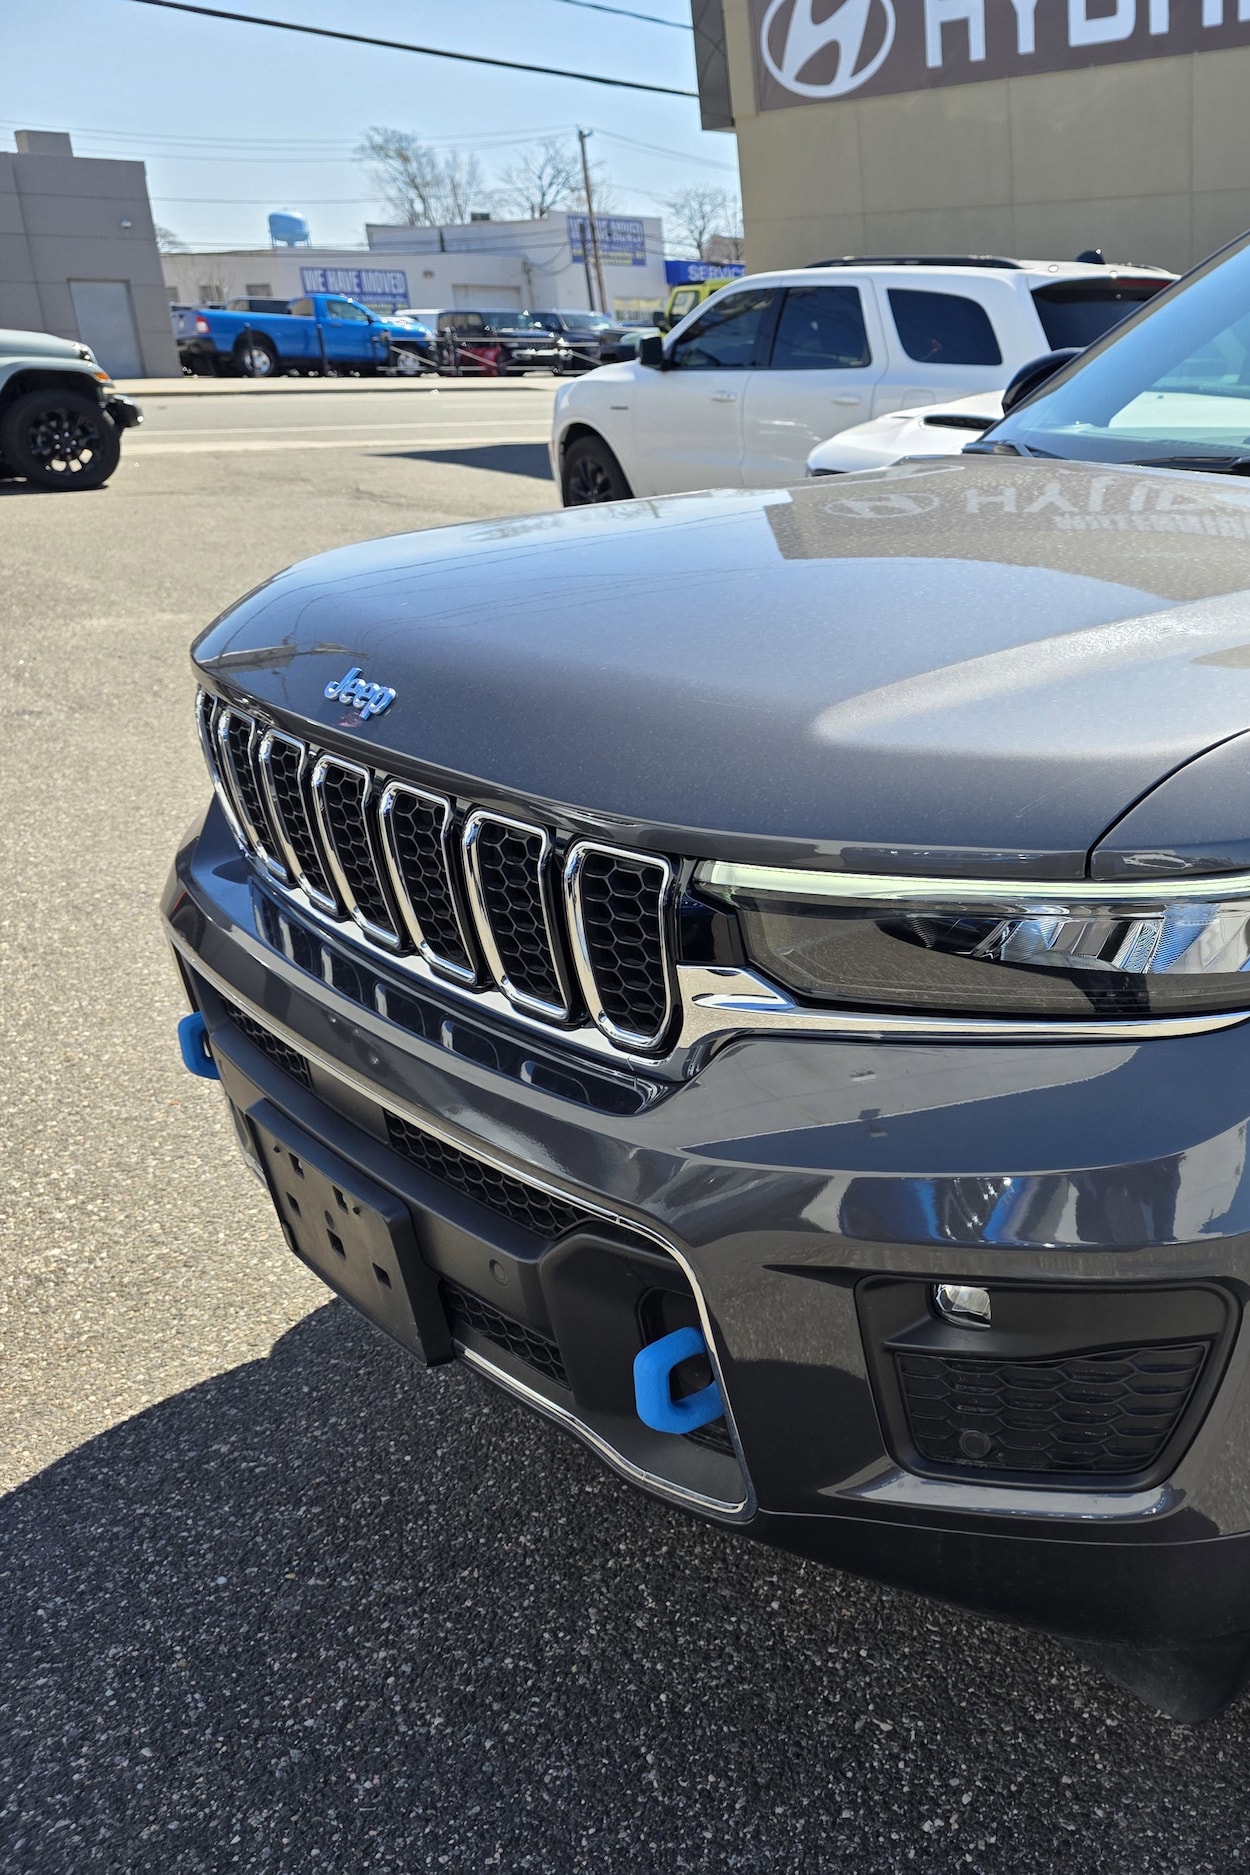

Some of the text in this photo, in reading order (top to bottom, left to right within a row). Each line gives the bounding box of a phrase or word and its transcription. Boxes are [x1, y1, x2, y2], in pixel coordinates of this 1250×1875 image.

[302, 269, 406, 296] WE HAVE MOVED
[324, 667, 397, 720] Jeep
